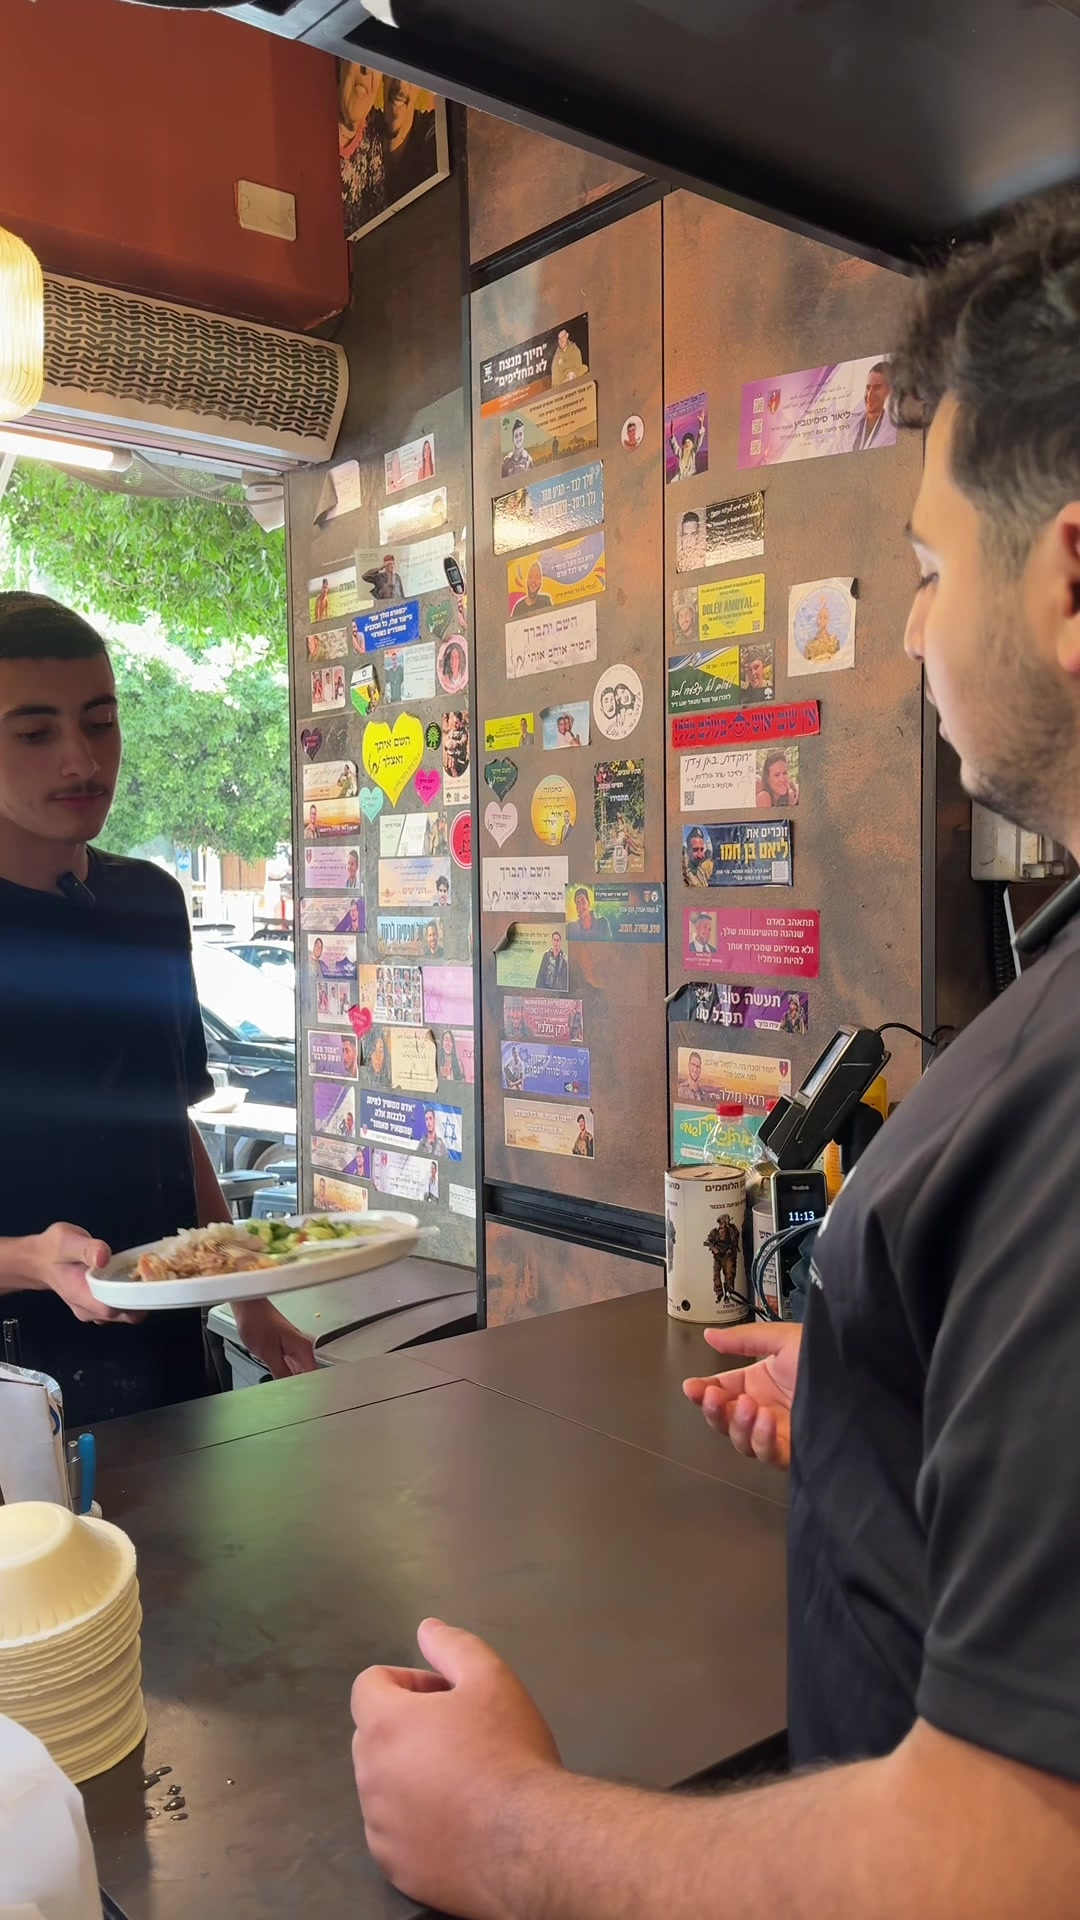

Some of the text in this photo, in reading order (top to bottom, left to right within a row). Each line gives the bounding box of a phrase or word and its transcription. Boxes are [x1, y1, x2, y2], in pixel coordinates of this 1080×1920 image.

[498, 354, 522, 371] מנצח
[536, 358, 548, 374] לא
[524, 616, 578, 645] השם יתברך
[527, 639, 592, 662] תמיד אוהב אותי
[375, 736, 411, 752] השם איתך
[703, 757, 719, 771] בגן
[746, 826, 788, 838] זוכרים את
[720, 838, 789, 864] ליאם בן חמו
[500, 866, 551, 881] השם יתברך
[502, 892, 563, 901] תמיד אוהב אותי
[767, 918, 814, 927] תתאהב באדם
[720, 927, 804, 938] שנהנה מהשיגעונות שלך,
[727, 943, 743, 952] אותך
[745, 944, 772, 952] שמכריח
[801, 946, 814, 954] ולא
[757, 954, 804, 965] להיות נורמלי!
[745, 993, 781, 1008] תעשה
[712, 1008, 743, 1025] תקבל
[720, 1090, 742, 1103] מילר
[746, 1094, 765, 1107] רואי
[705, 1181, 740, 1192] הלוחמים
[788, 1211, 815, 1221] 11:13
